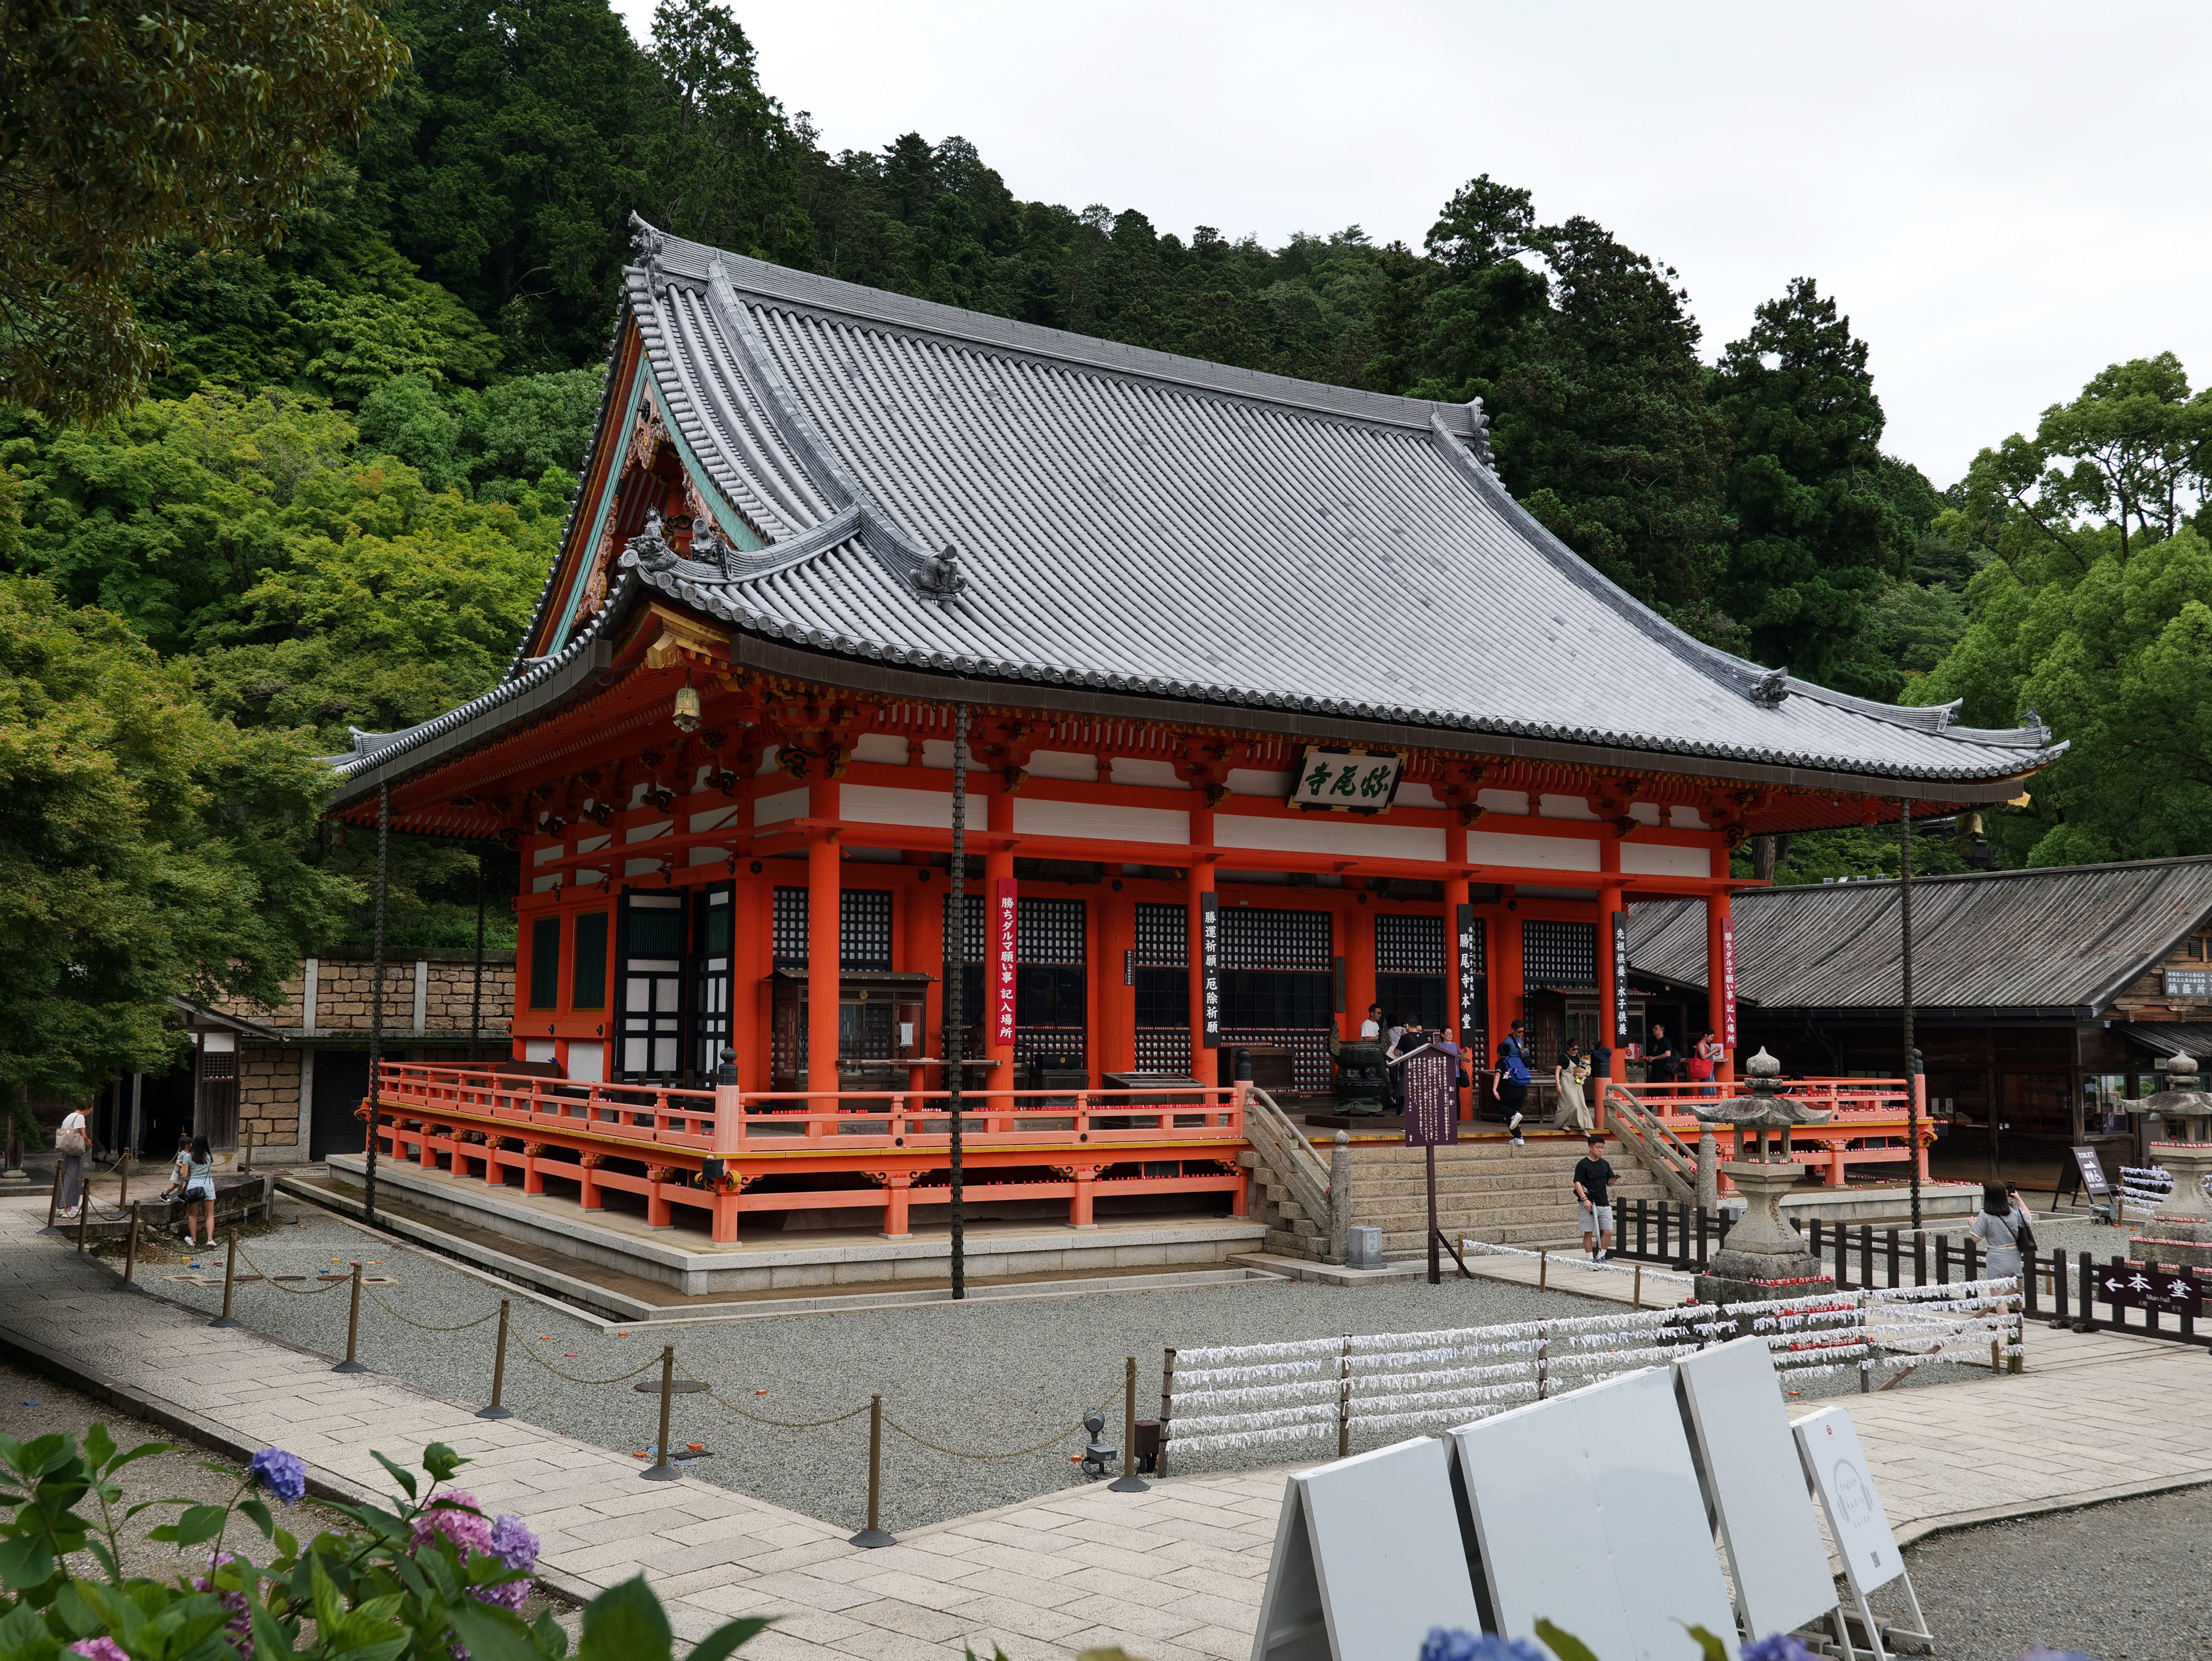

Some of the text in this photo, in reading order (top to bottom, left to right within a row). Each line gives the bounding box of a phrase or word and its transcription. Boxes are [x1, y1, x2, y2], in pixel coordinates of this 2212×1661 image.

[1305, 762, 1391, 798] 勝尾寺
[1000, 897, 1014, 1039] 勝ちダルマ願い事 記入場所
[1205, 911, 1218, 1033] 勝運祈願・厄除祈願
[1460, 933, 1471, 1029] 勝尾寺本堂
[1616, 928, 1627, 1035] 先祖供養・水子供養
[1724, 932, 1735, 1044] 勝ちダルマ願い事 記入場所
[1449, 1085, 1453, 1105] 本堂
[2127, 1273, 2192, 1299] 本堂
[1839, 1477, 1857, 1491] English
[1847, 1497, 1864, 1509] Audio
[1853, 1515, 1870, 1528] Guide
